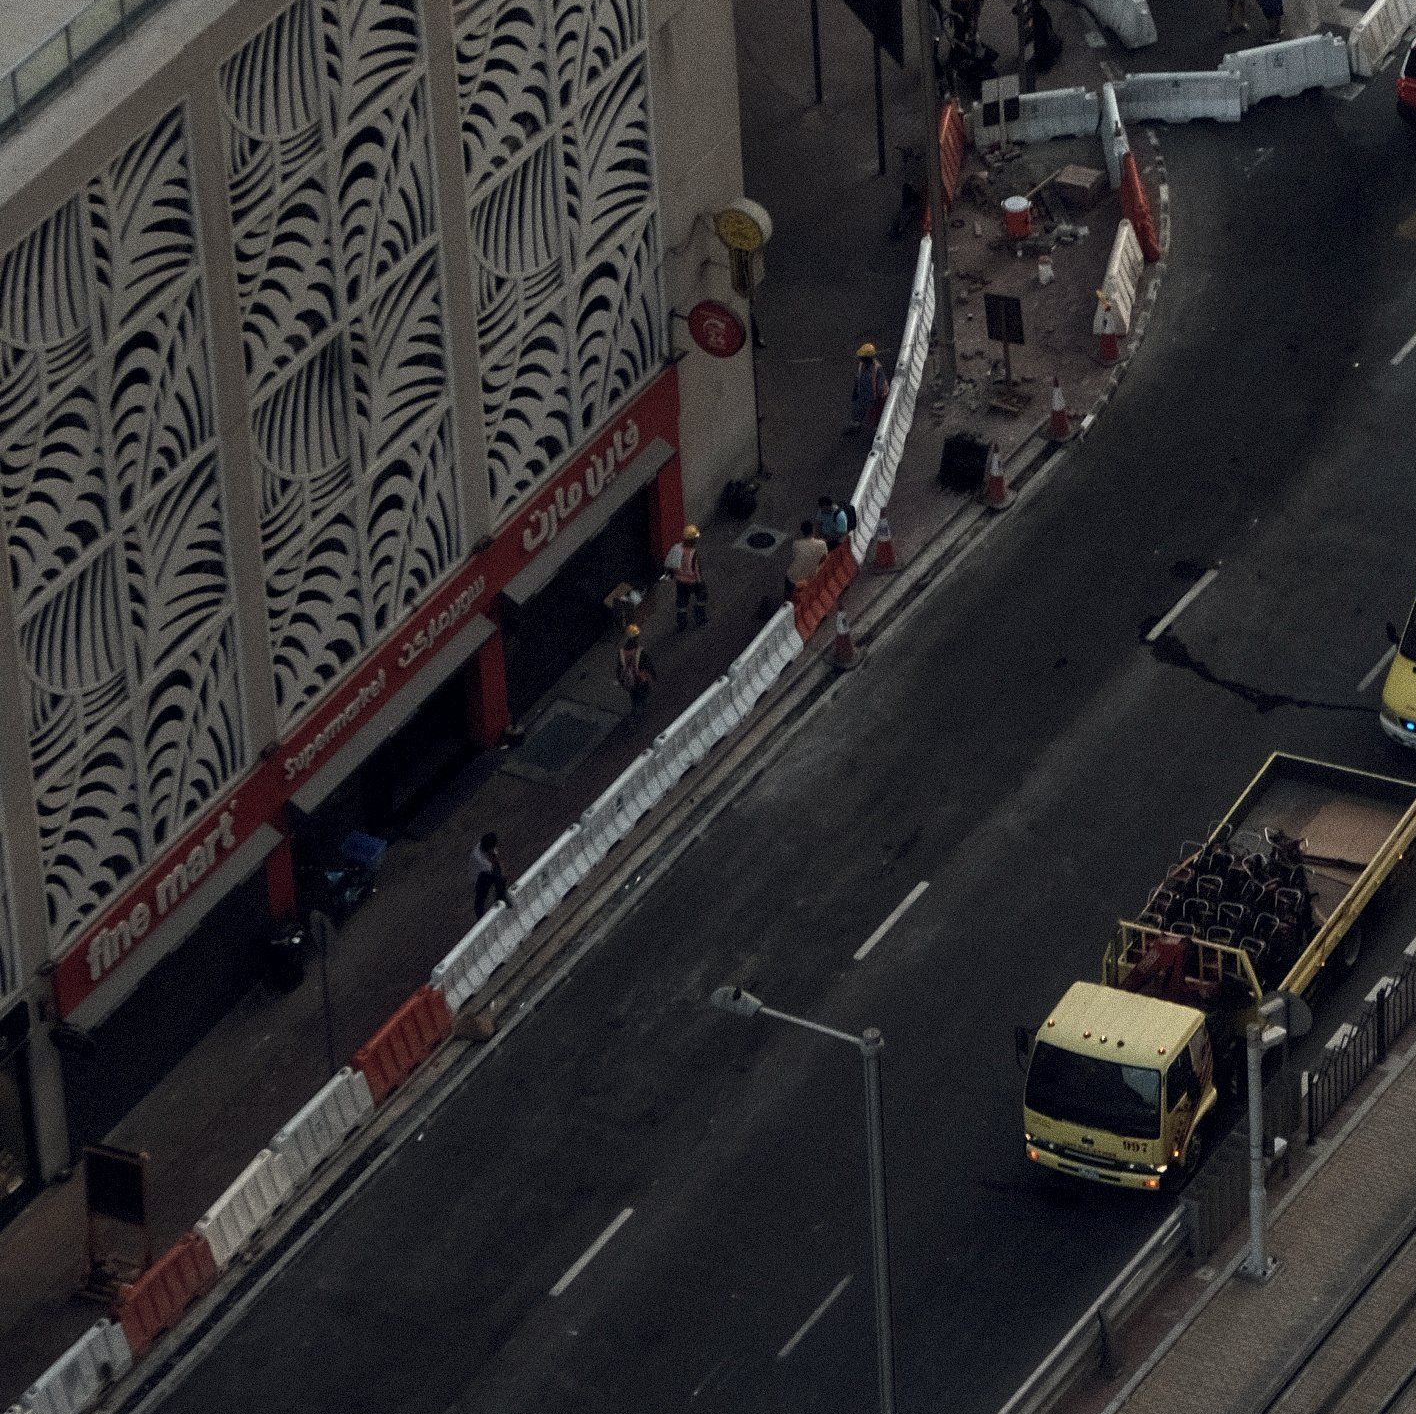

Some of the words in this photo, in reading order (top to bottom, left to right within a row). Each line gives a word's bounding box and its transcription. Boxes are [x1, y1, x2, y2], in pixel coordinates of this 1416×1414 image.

[86, 902, 150, 982] fine
[155, 810, 236, 916] mart
[1123, 1140, 1148, 1153] 997
